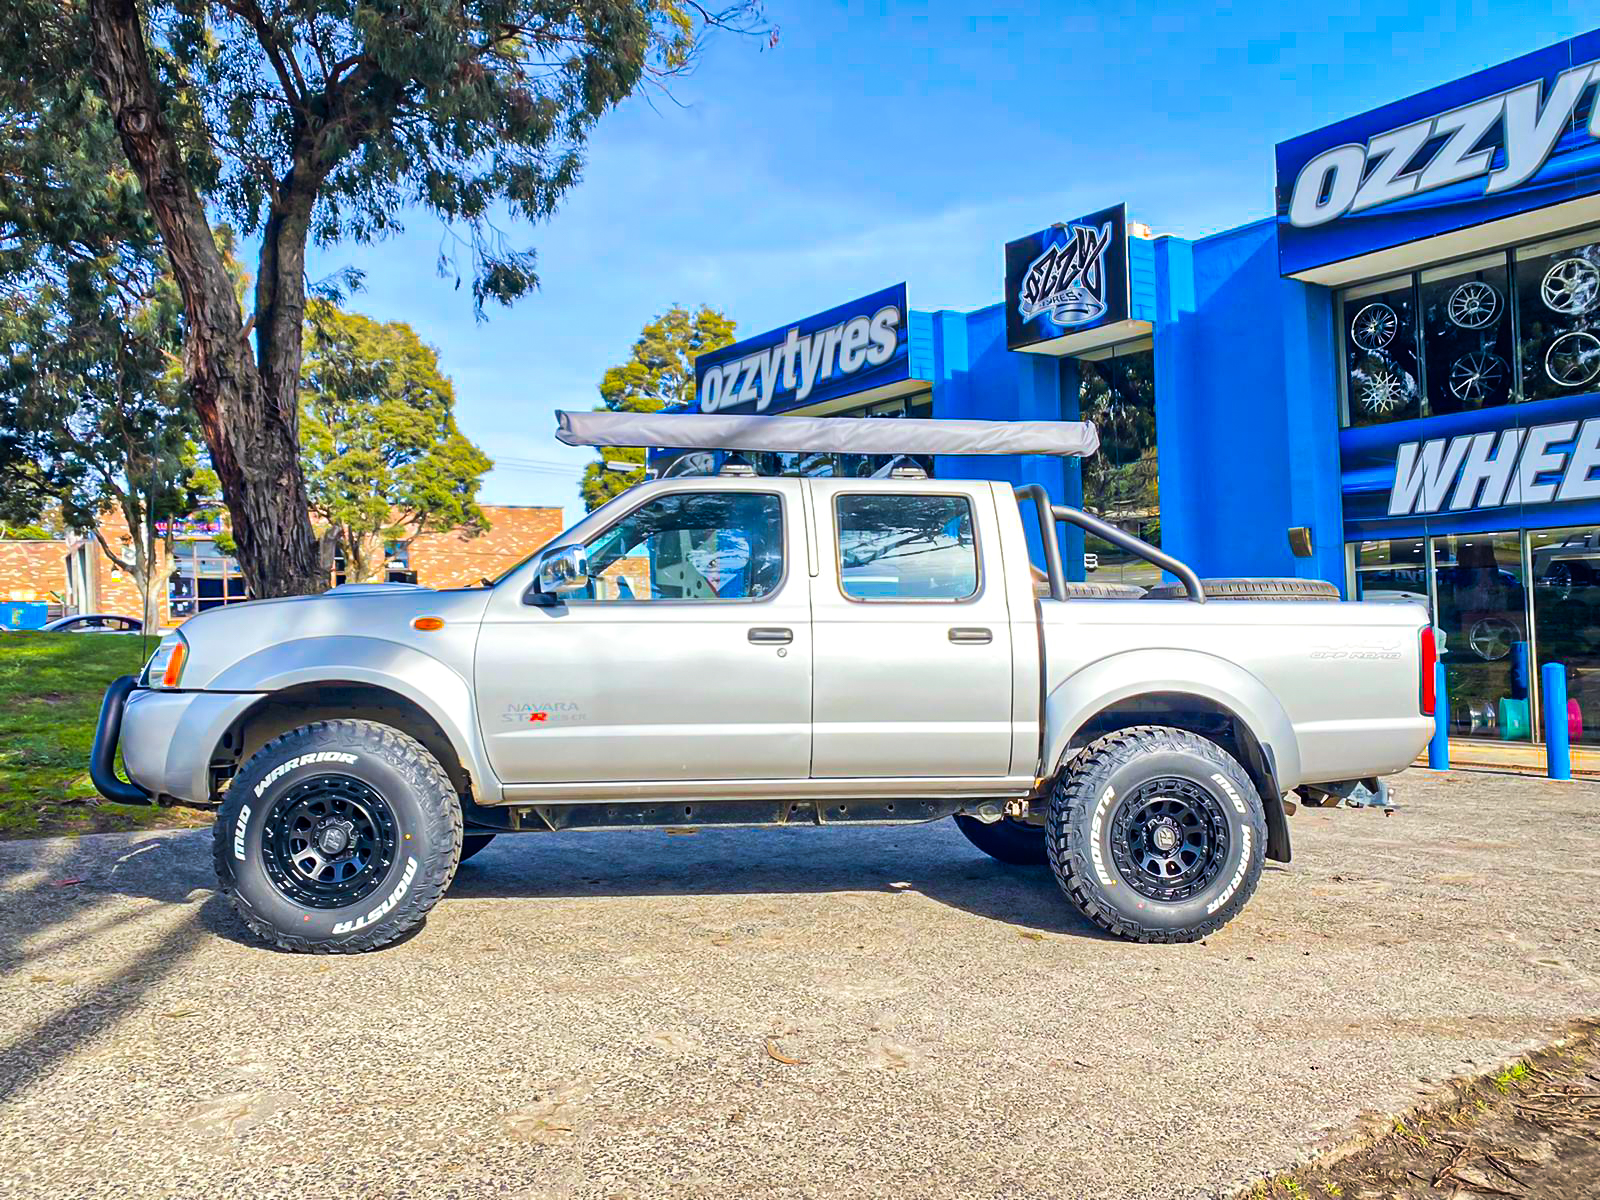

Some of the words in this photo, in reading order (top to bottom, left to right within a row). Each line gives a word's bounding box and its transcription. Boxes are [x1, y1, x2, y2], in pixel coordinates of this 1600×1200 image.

[1289, 60, 1600, 227] ozzy
[508, 702, 579, 712] NAVARA
[234, 804, 251, 861] MUD
[253, 751, 358, 798] WARRIOR
[1090, 786, 1116, 885] MONSTA
[1211, 773, 1247, 813] MUD
[332, 857, 418, 935] MONSTA
[1207, 824, 1251, 914] WARRIOR
